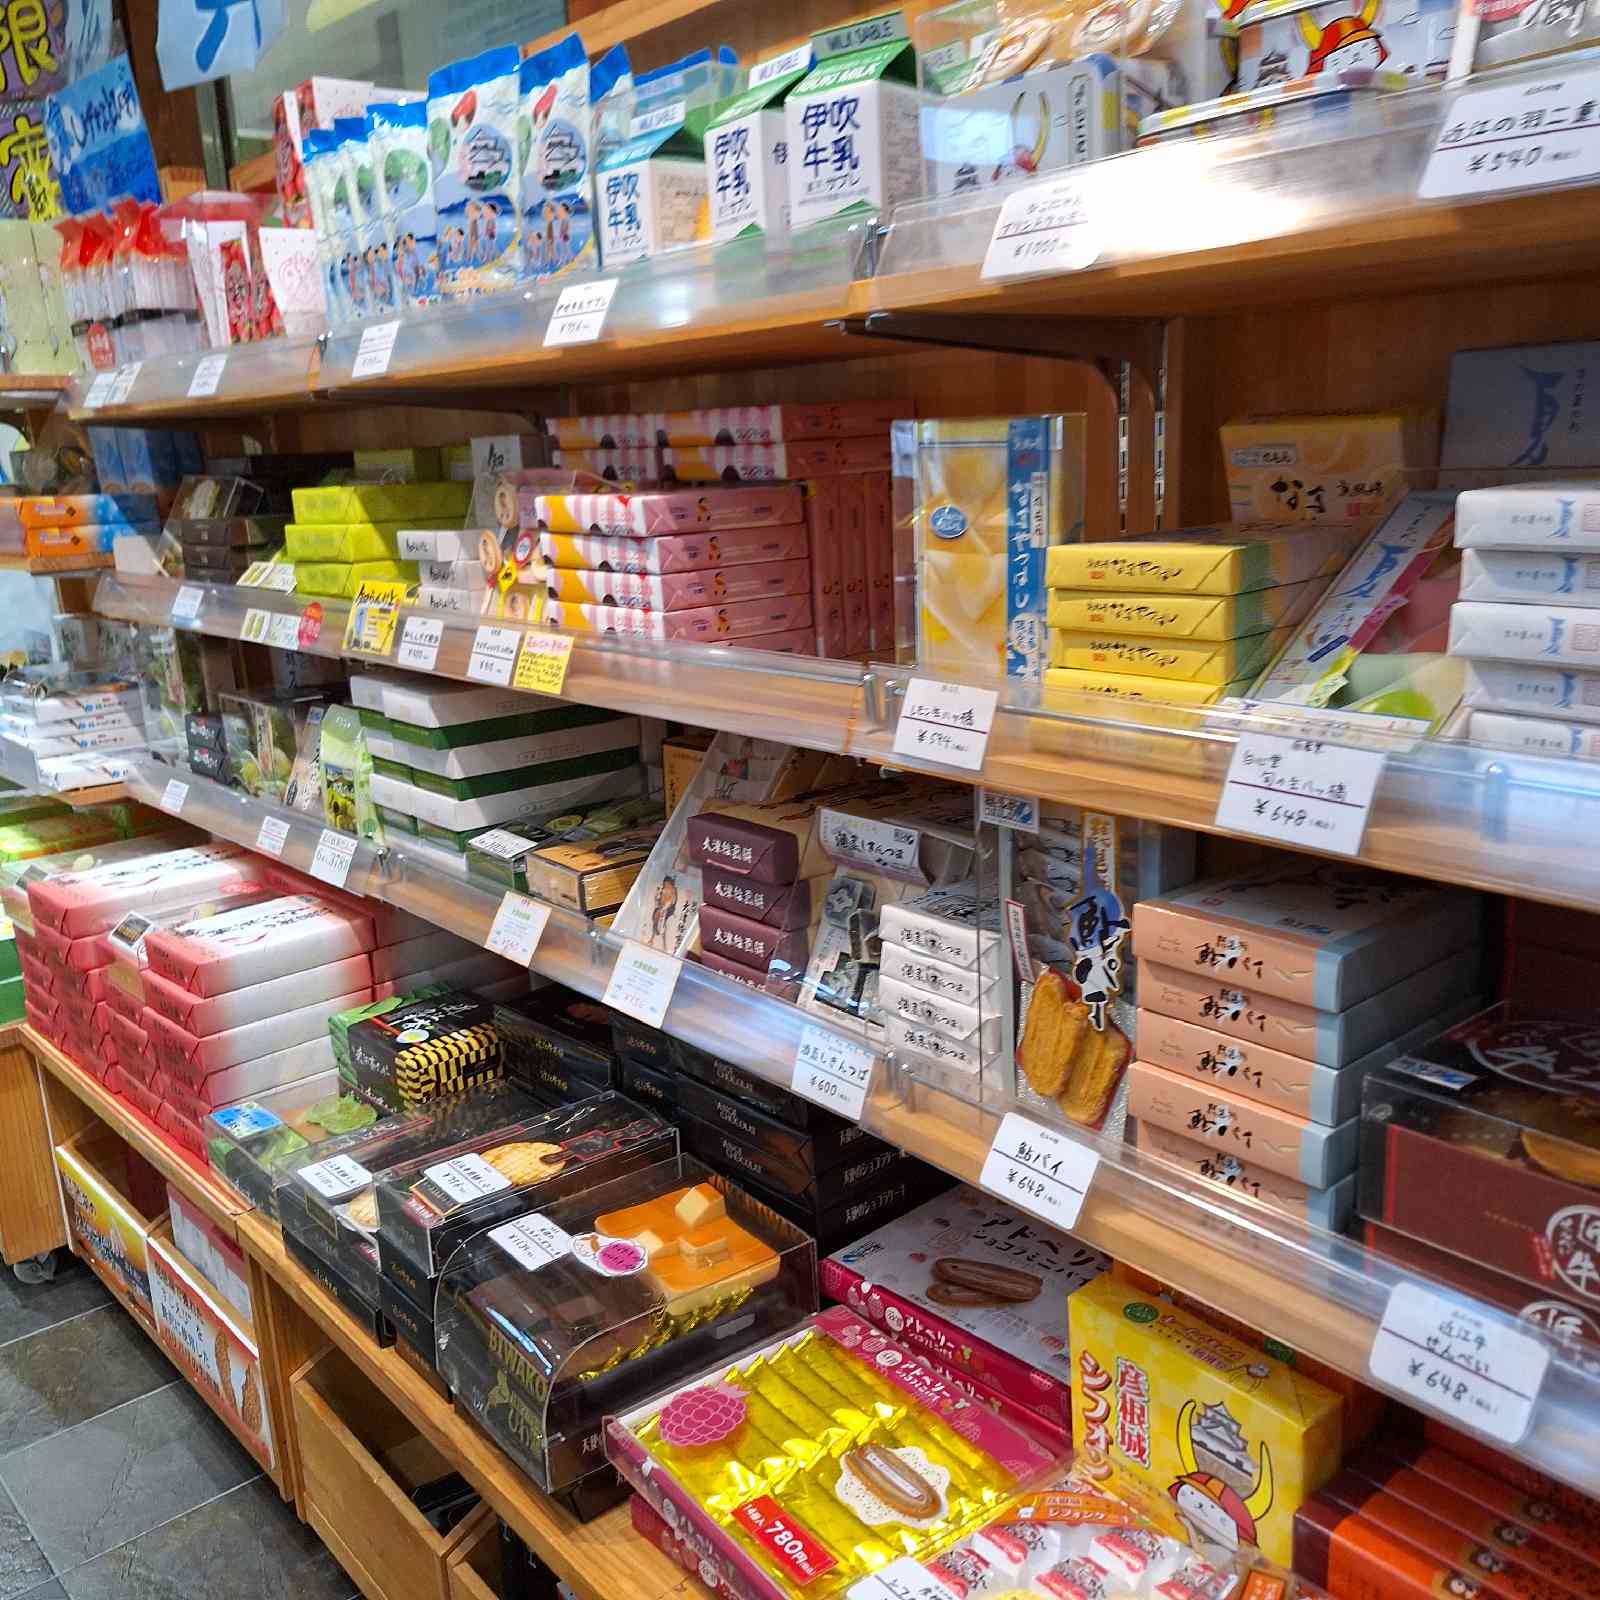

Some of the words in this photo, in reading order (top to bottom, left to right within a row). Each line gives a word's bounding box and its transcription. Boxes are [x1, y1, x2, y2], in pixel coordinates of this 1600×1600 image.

[801, 95, 861, 141] 伊吹
[1440, 100, 1600, 143] 近江の羽二重
[803, 134, 860, 178] 牛乳
[1007, 1167, 1045, 1199] ¥648
[1407, 1357, 1468, 1402] ¥648
